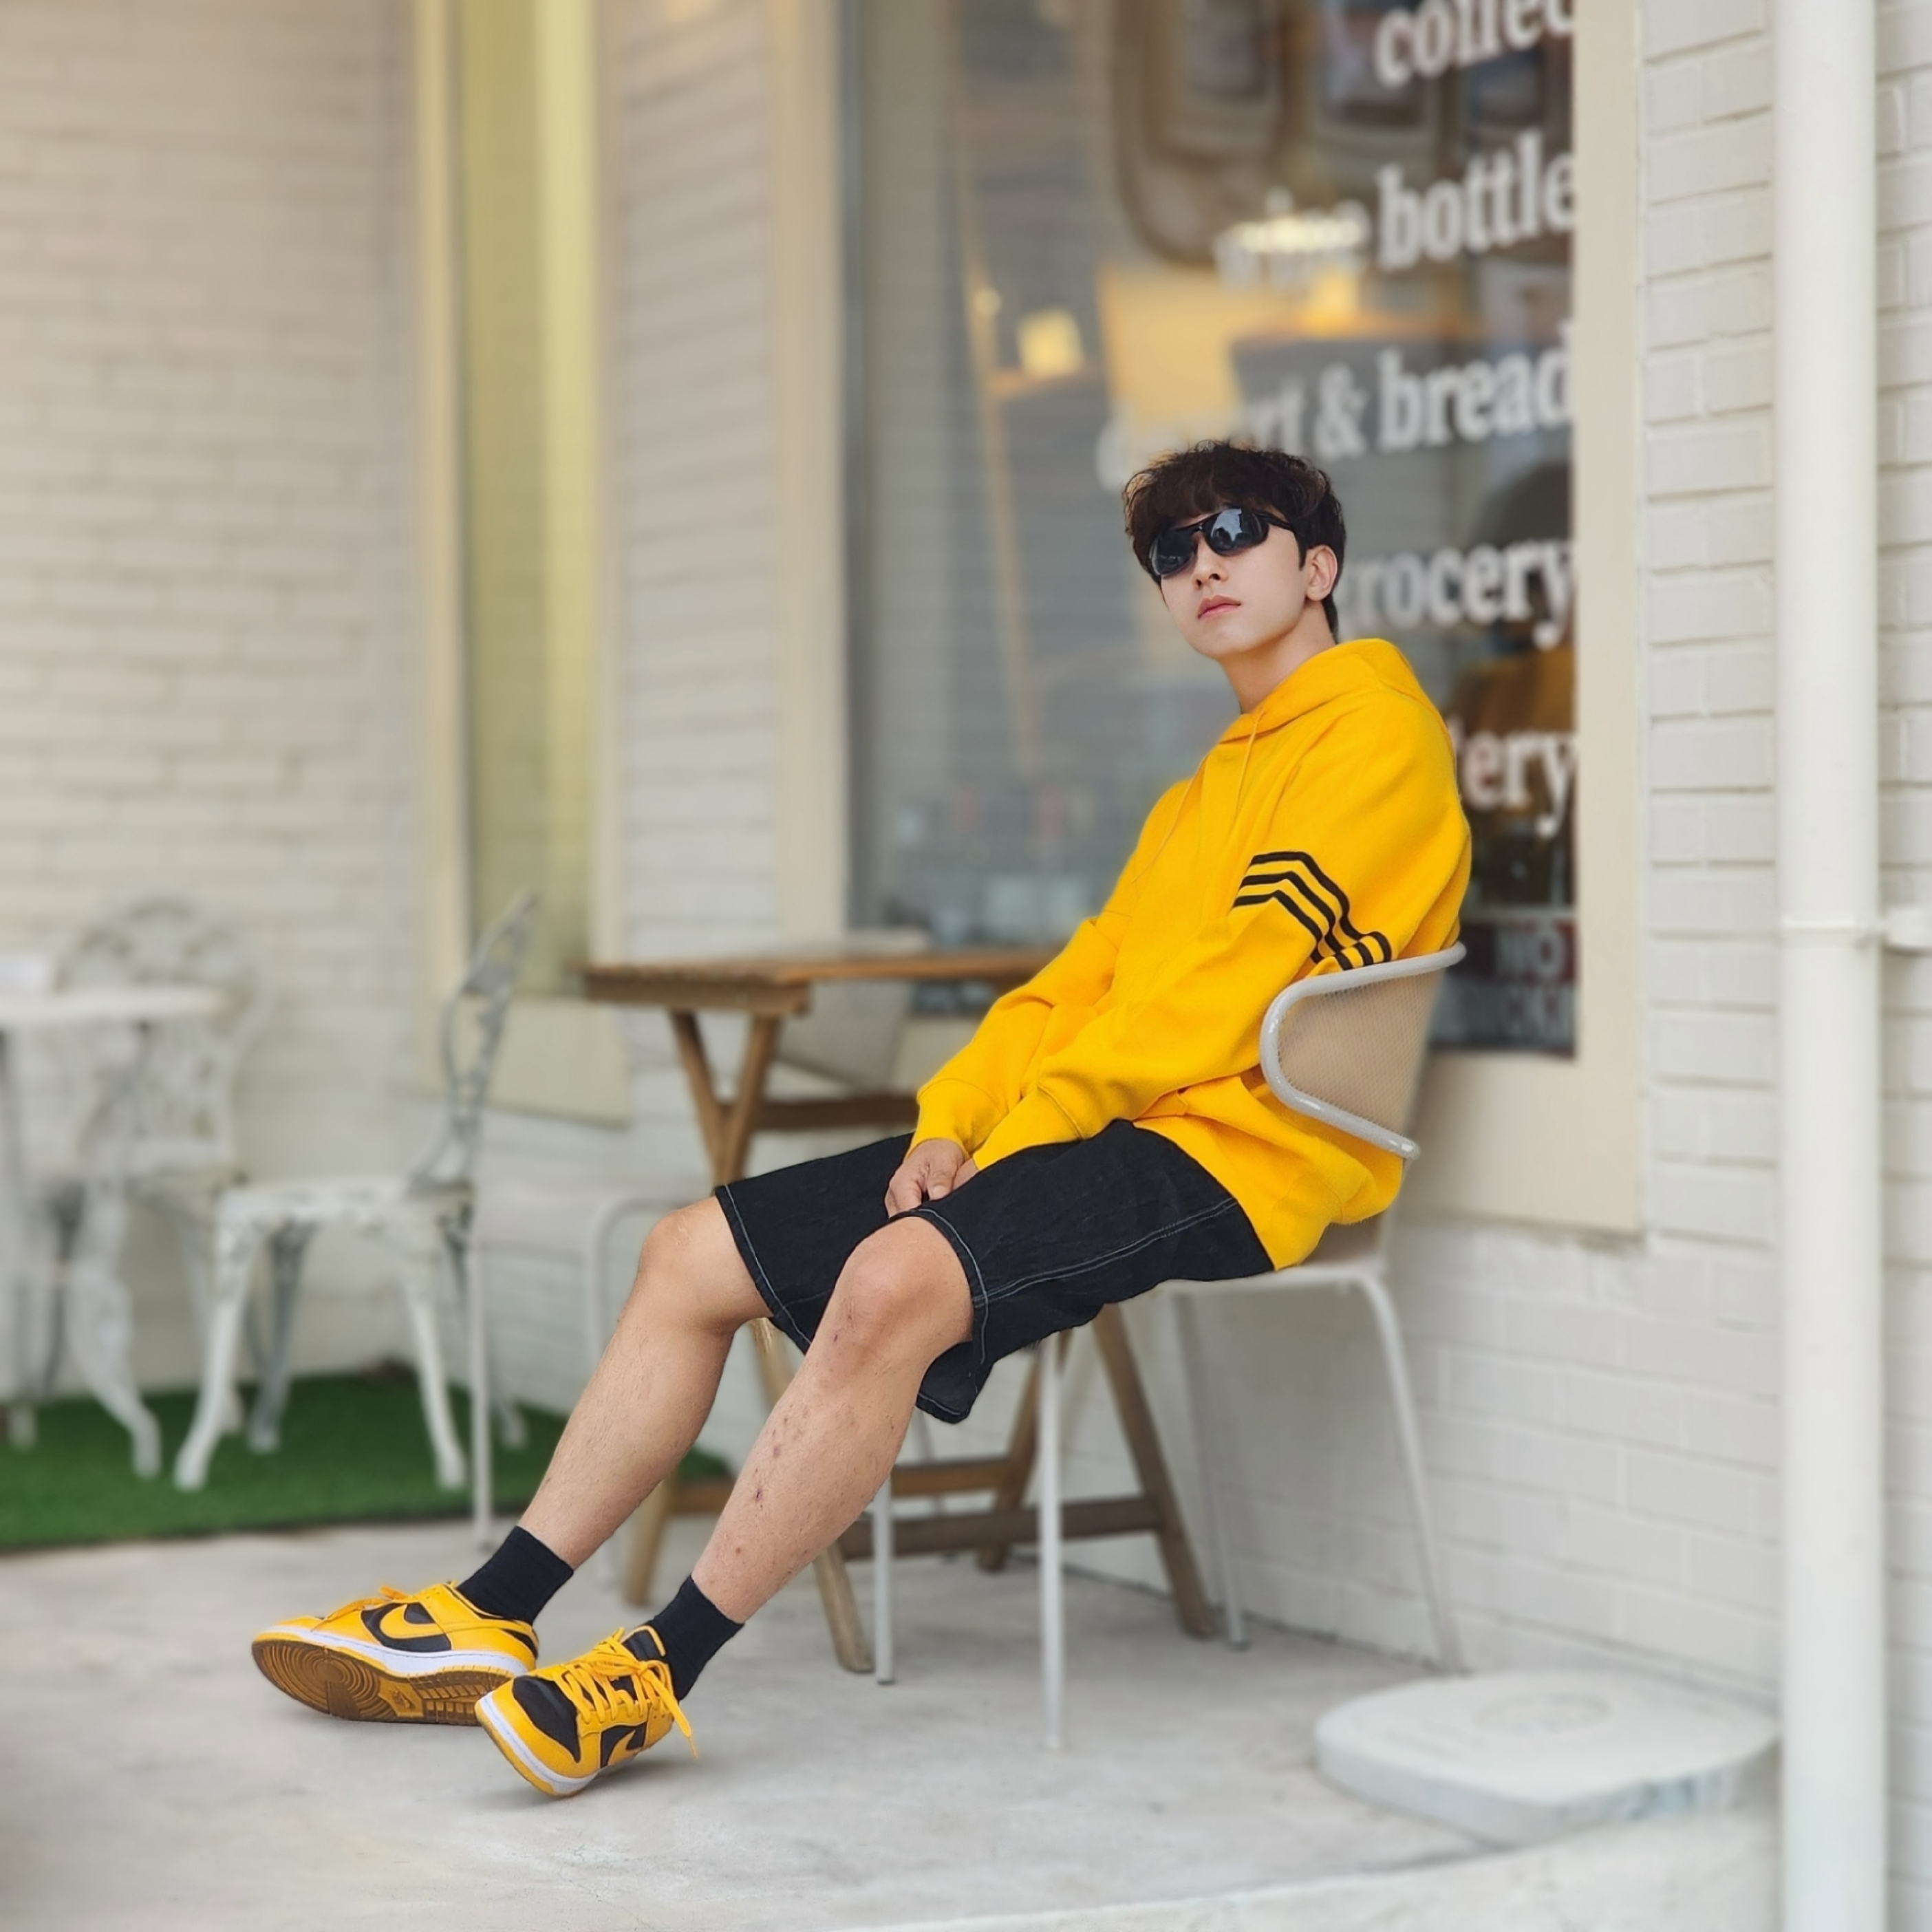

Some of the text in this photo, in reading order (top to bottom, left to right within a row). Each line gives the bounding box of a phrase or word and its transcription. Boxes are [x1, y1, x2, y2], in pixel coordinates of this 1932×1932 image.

[1377, 129, 1574, 272] bottle
[1315, 363, 1367, 459] &
[1378, 321, 1574, 451] bread
[1446, 716, 1574, 840] ery
